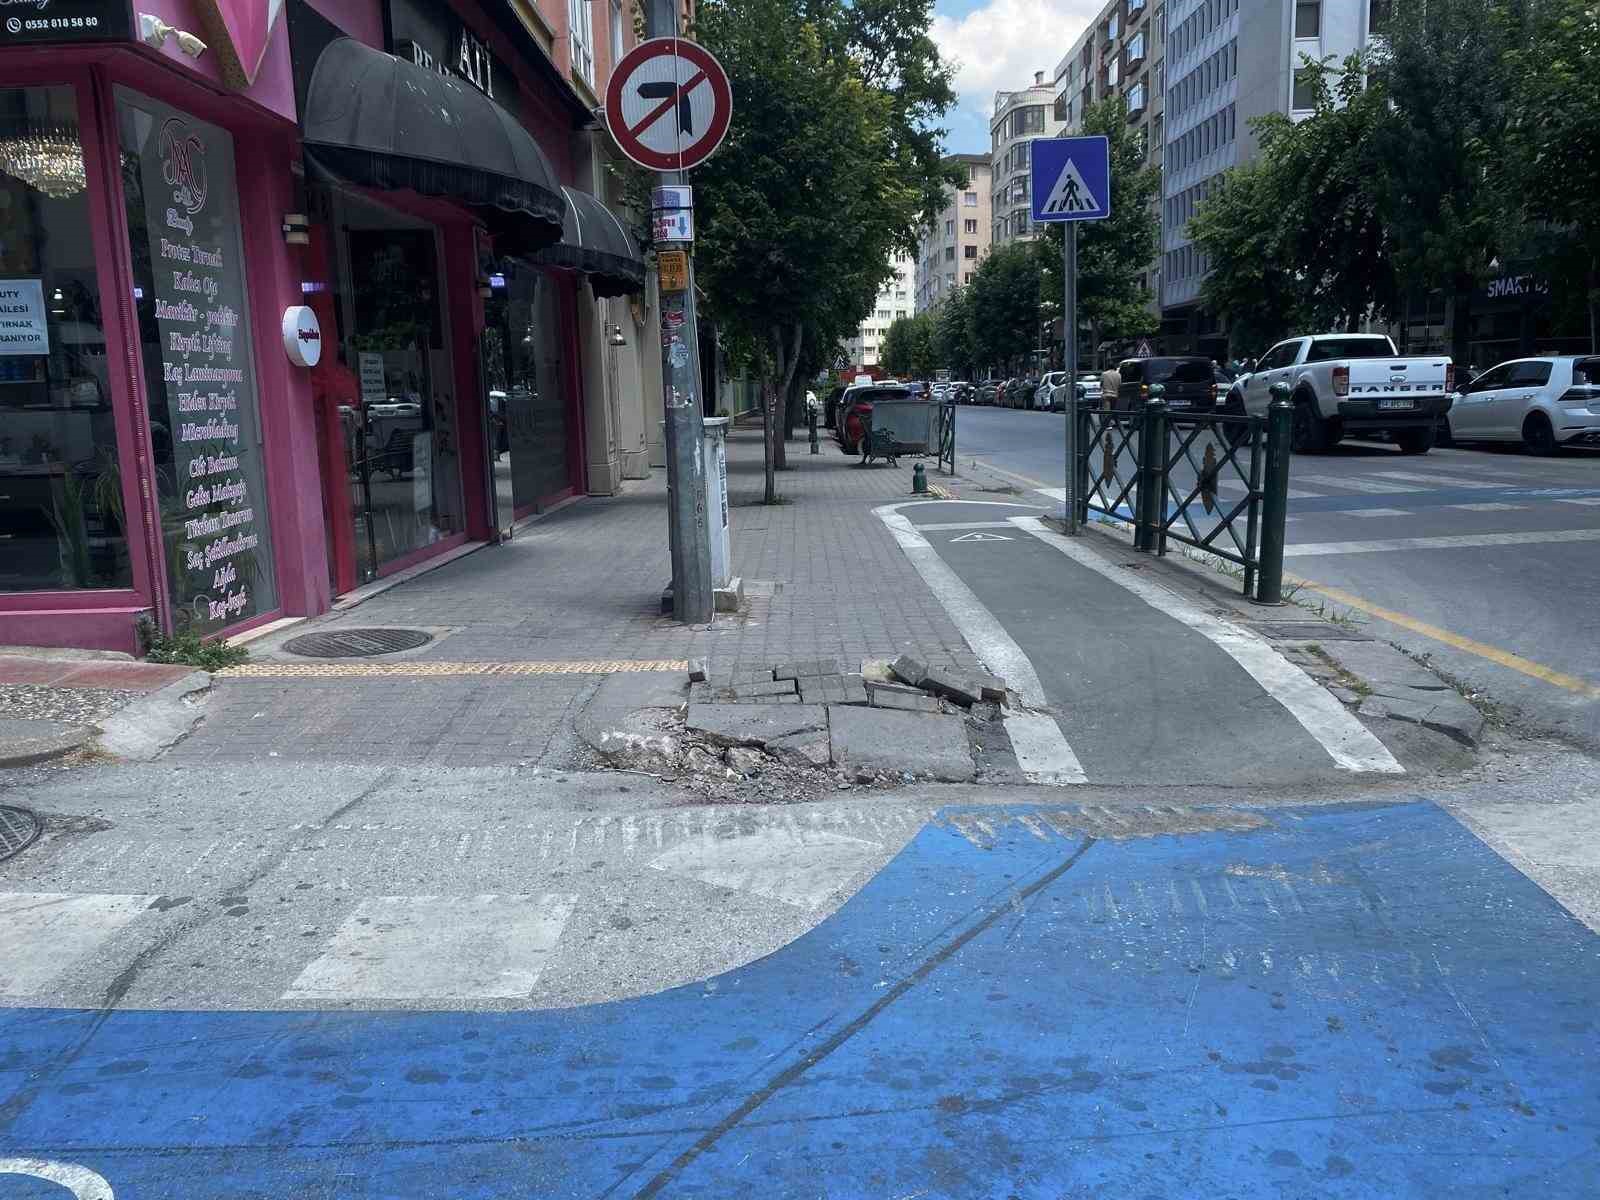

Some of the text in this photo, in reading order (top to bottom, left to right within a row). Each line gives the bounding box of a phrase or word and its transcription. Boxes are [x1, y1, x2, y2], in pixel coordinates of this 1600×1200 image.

[25, 20, 48, 29] 0552
[51, 18, 69, 28] 818
[85, 17, 98, 26] 80
[0, 320, 33, 328] IRNAK
[1351, 384, 1443, 393] RANGER
